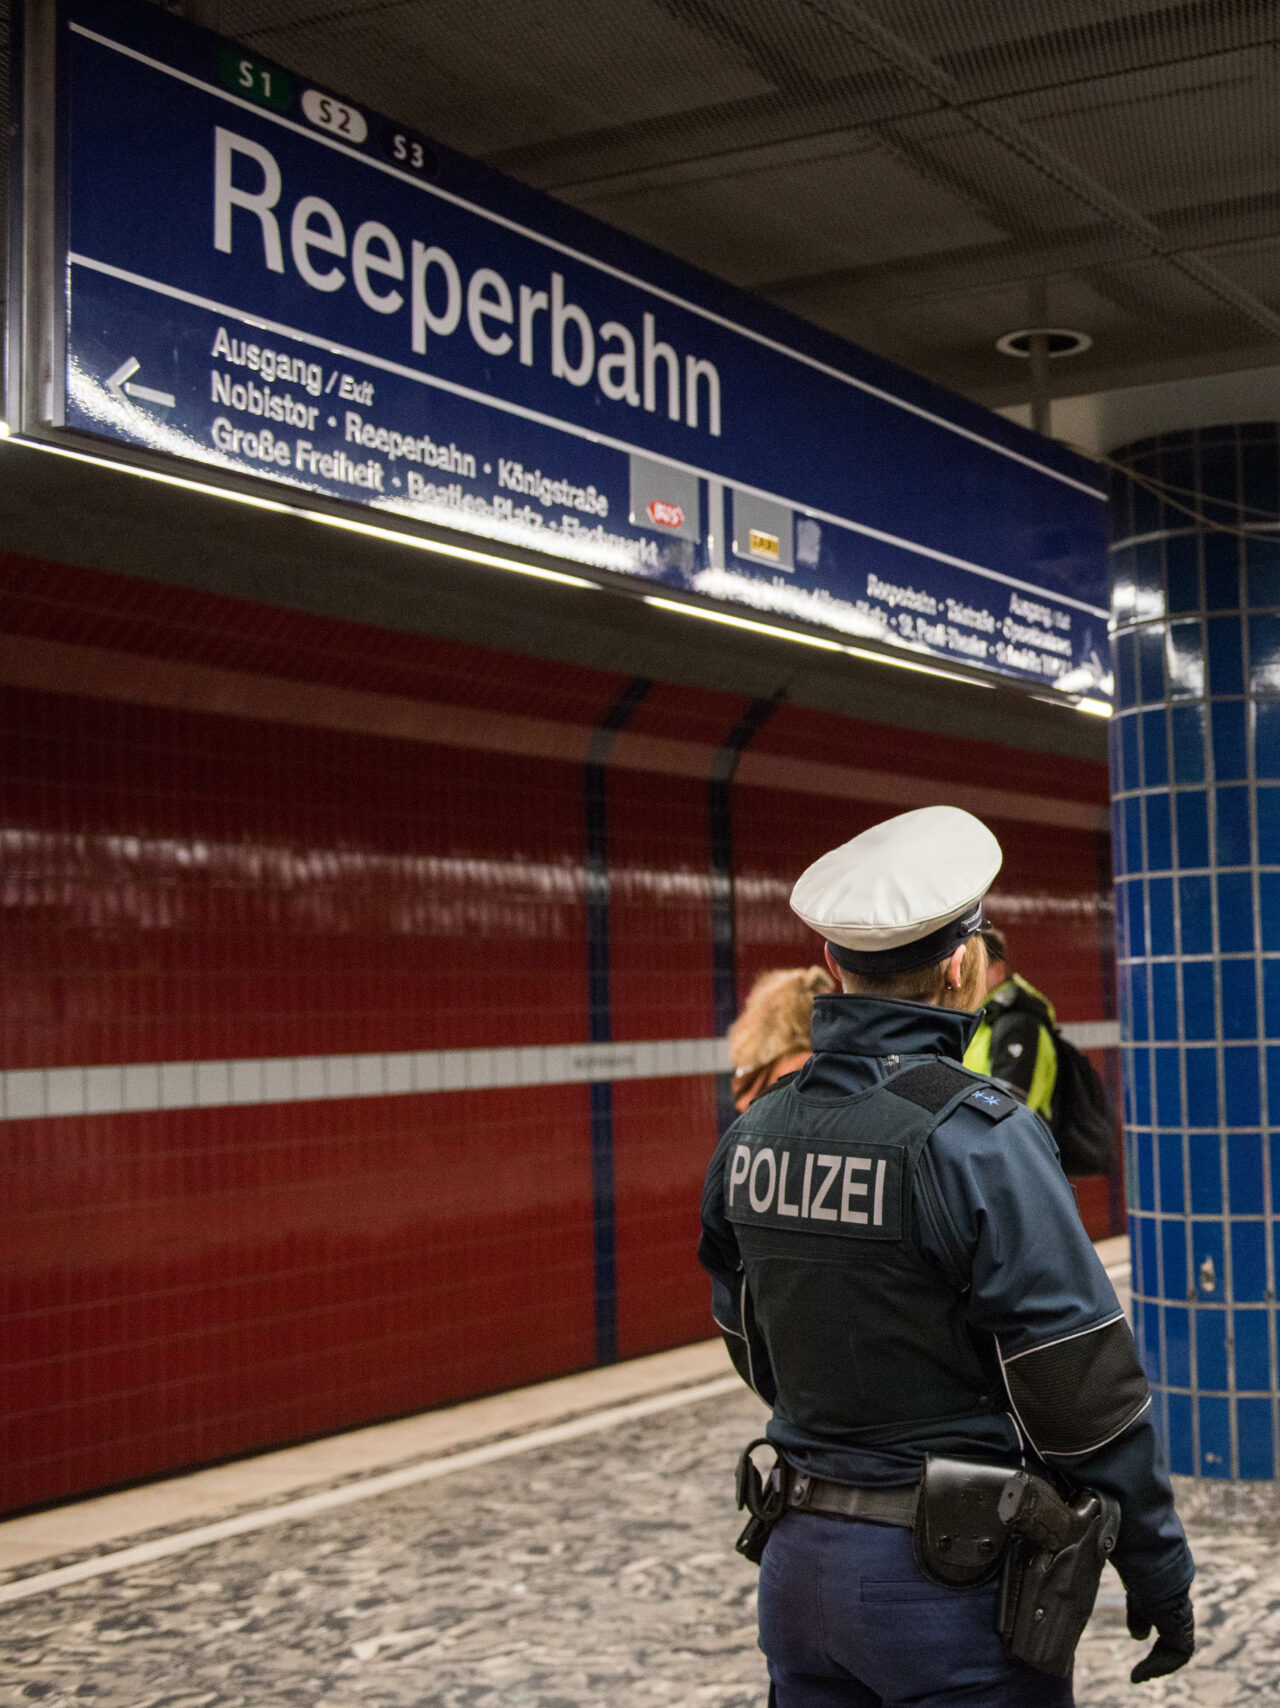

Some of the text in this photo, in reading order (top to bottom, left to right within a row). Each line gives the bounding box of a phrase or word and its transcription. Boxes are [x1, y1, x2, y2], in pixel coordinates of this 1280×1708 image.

[239, 60, 424, 168] S1 S2 S3
[213, 125, 722, 437] Reeperbahn
[211, 326, 322, 396] Ausgang
[211, 369, 609, 518] Nobistor Reeperbahn Königstraße
[211, 416, 292, 467] Große
[295, 438, 385, 493] Freiheit
[729, 1144, 887, 1226] POLIZEI
